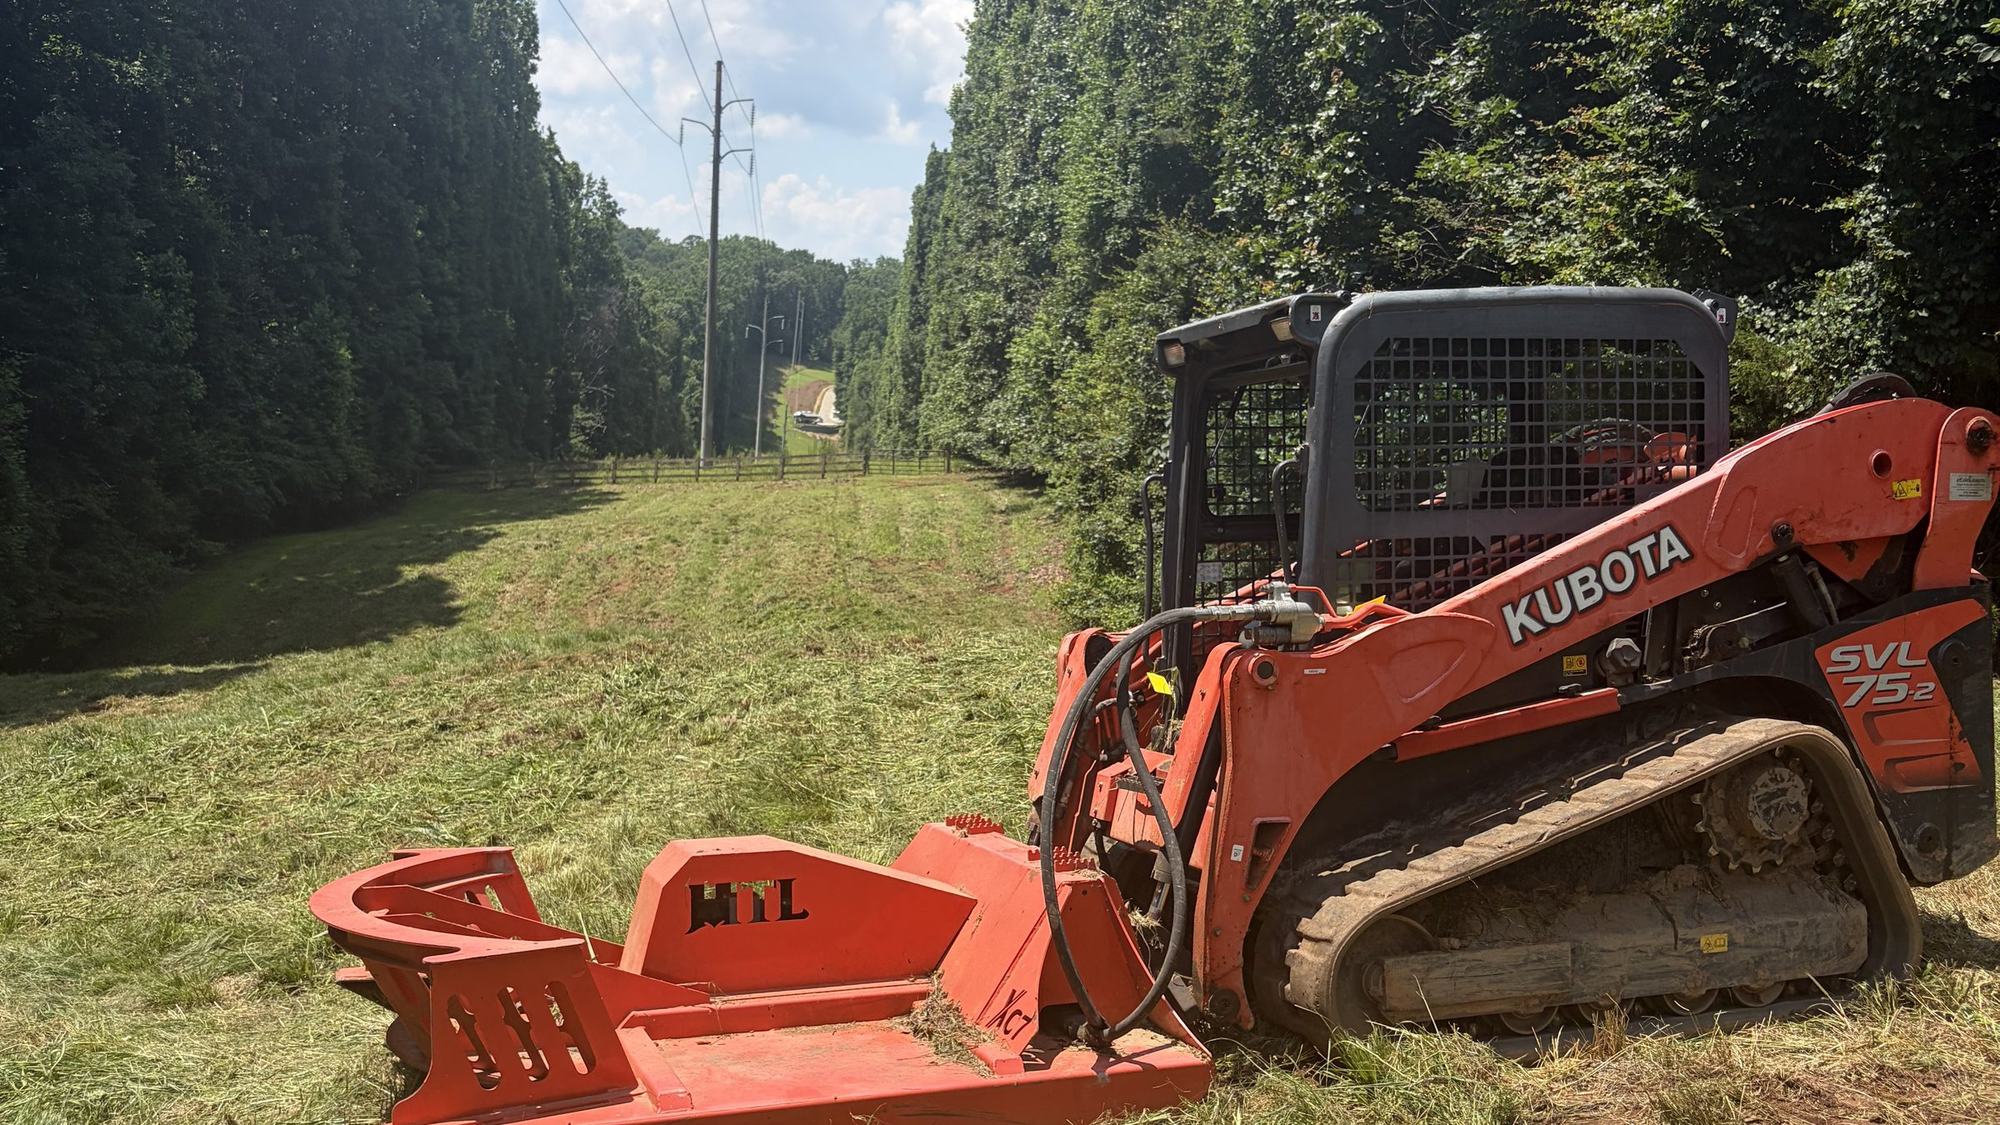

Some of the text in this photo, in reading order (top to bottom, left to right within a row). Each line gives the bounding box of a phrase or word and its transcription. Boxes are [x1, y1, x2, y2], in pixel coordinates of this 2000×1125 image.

[1501, 525, 1692, 645] KUBOTA
[1826, 641, 1927, 674] SVL
[1842, 672, 1936, 708] 75-2
